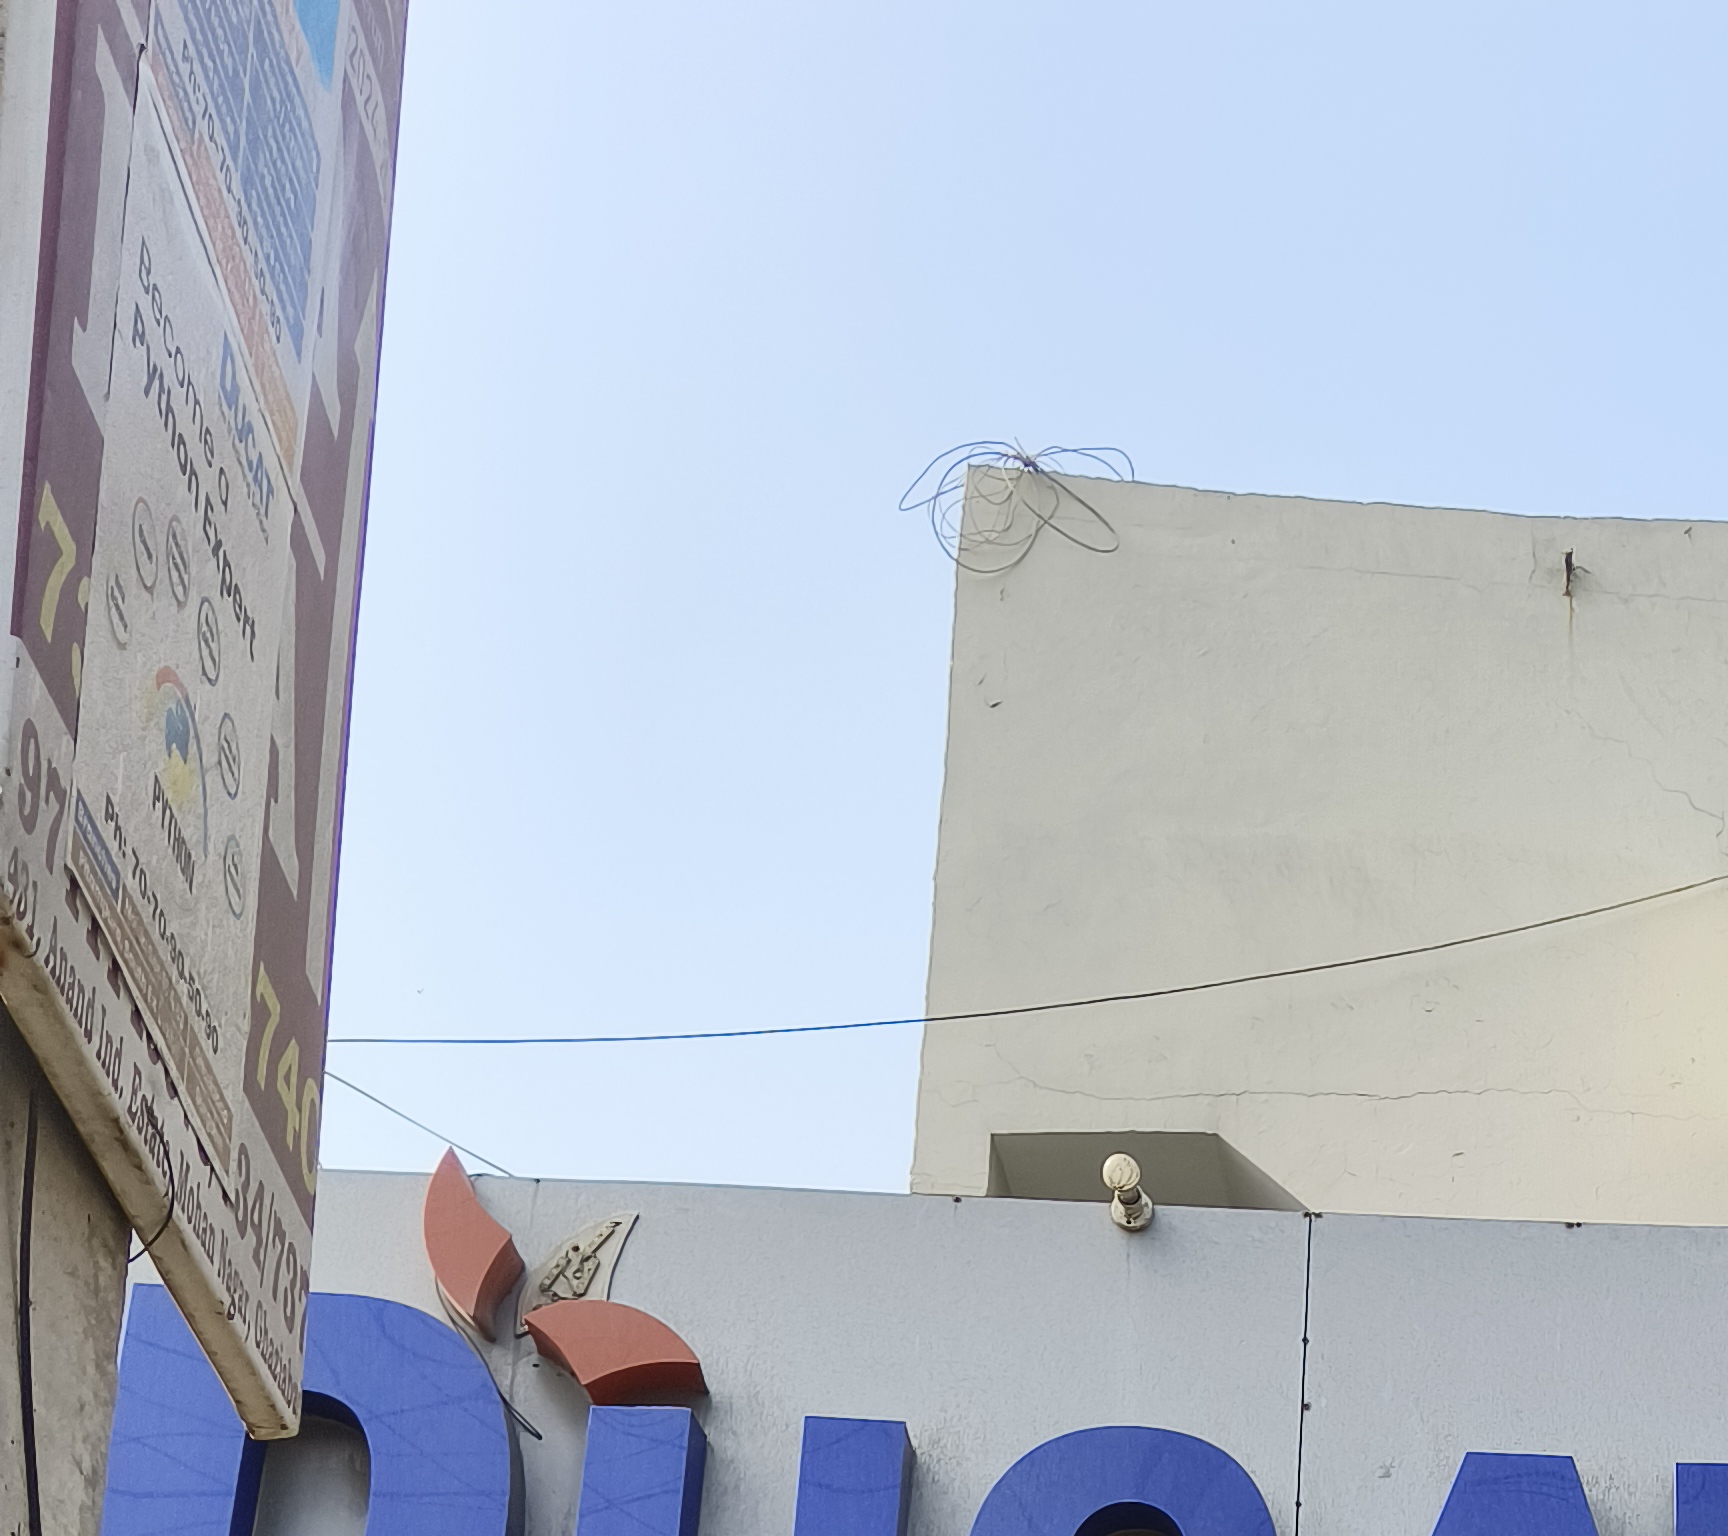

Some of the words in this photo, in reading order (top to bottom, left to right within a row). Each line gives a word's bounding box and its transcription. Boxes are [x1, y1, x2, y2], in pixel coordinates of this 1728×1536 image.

[131, 300, 199, 512] Python
[202, 491, 256, 662] Expert
[138, 235, 215, 467] Become
[218, 467, 229, 514] a
[220, 330, 274, 520] DUCAT
[152, 772, 195, 895] PYTHON
[44, 916, 96, 1045] Anand
[176, 1150, 216, 1266] Mohan
